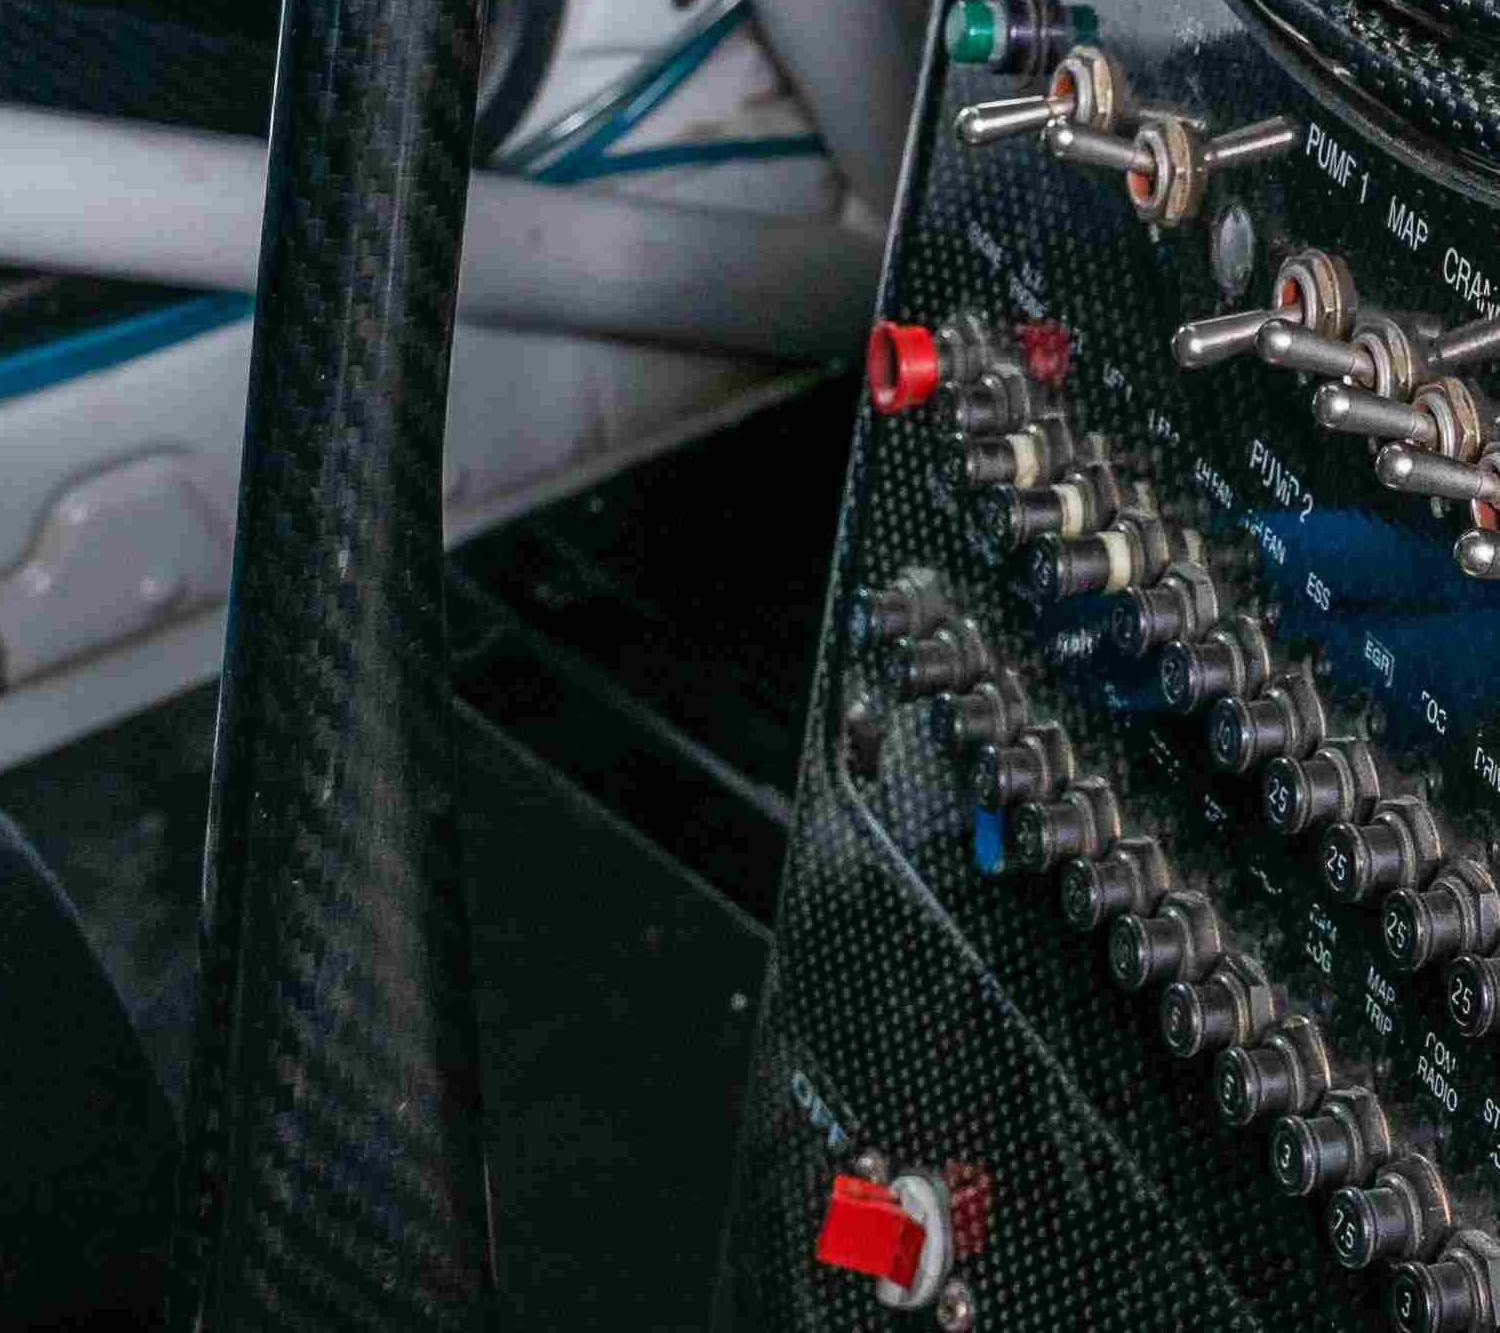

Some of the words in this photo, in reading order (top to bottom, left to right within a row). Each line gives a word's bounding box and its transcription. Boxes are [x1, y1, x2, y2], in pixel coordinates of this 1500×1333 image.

[1359, 172, 1370, 204] 1
[1387, 194, 1429, 251] MAP
[1300, 492, 1314, 523] 2
[1305, 570, 1332, 612] ESS
[1268, 778, 1290, 813] 25
[1326, 844, 1349, 882] 25
[1387, 911, 1408, 949] 25
[1366, 965, 1398, 1005] MAP
[1451, 977, 1473, 1015] 25
[1365, 993, 1393, 1035] TRIP
[1417, 1055, 1458, 1113] RADIO
[1280, 1143, 1292, 1170] 3
[1401, 1293, 1413, 1320] 3
